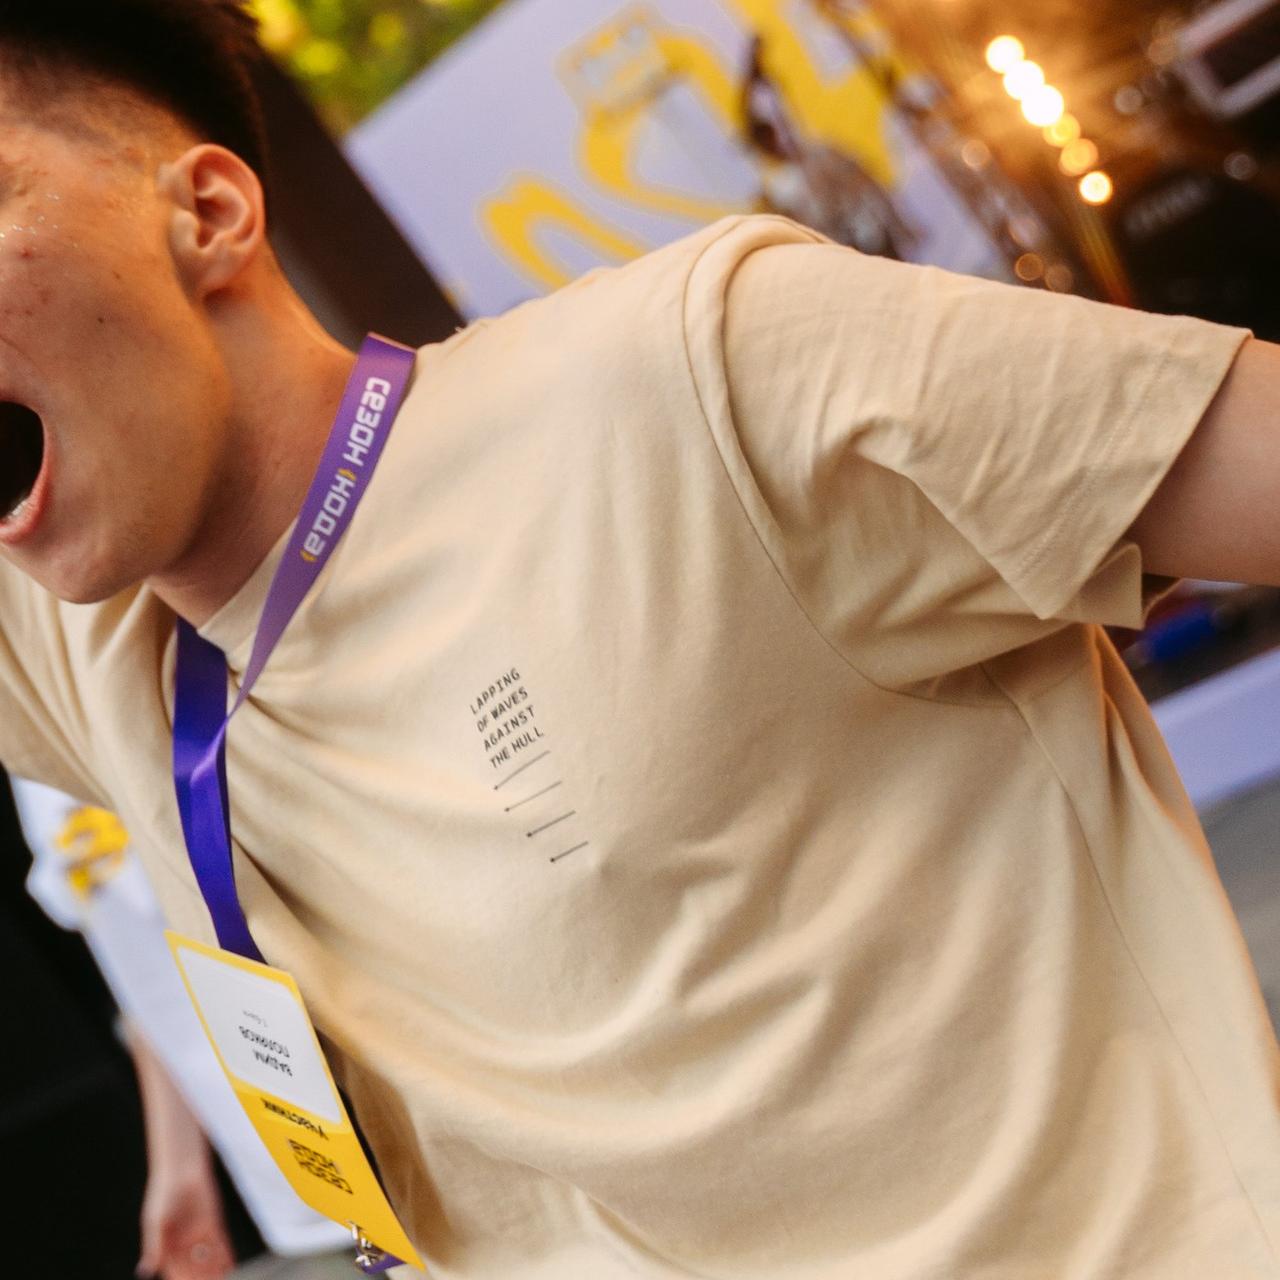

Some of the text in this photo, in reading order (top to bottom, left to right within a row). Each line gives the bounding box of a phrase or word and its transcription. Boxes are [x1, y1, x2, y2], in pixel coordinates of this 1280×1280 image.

[470, 667, 521, 715] LAPPING
[477, 686, 529, 733] OF WAVES
[483, 705, 536, 752] AGAINST
[489, 726, 545, 769] THE HULL
[238, 1024, 291, 1059] ПОЛЯКОВ
[252, 1047, 294, 1078] ВАДИМ
